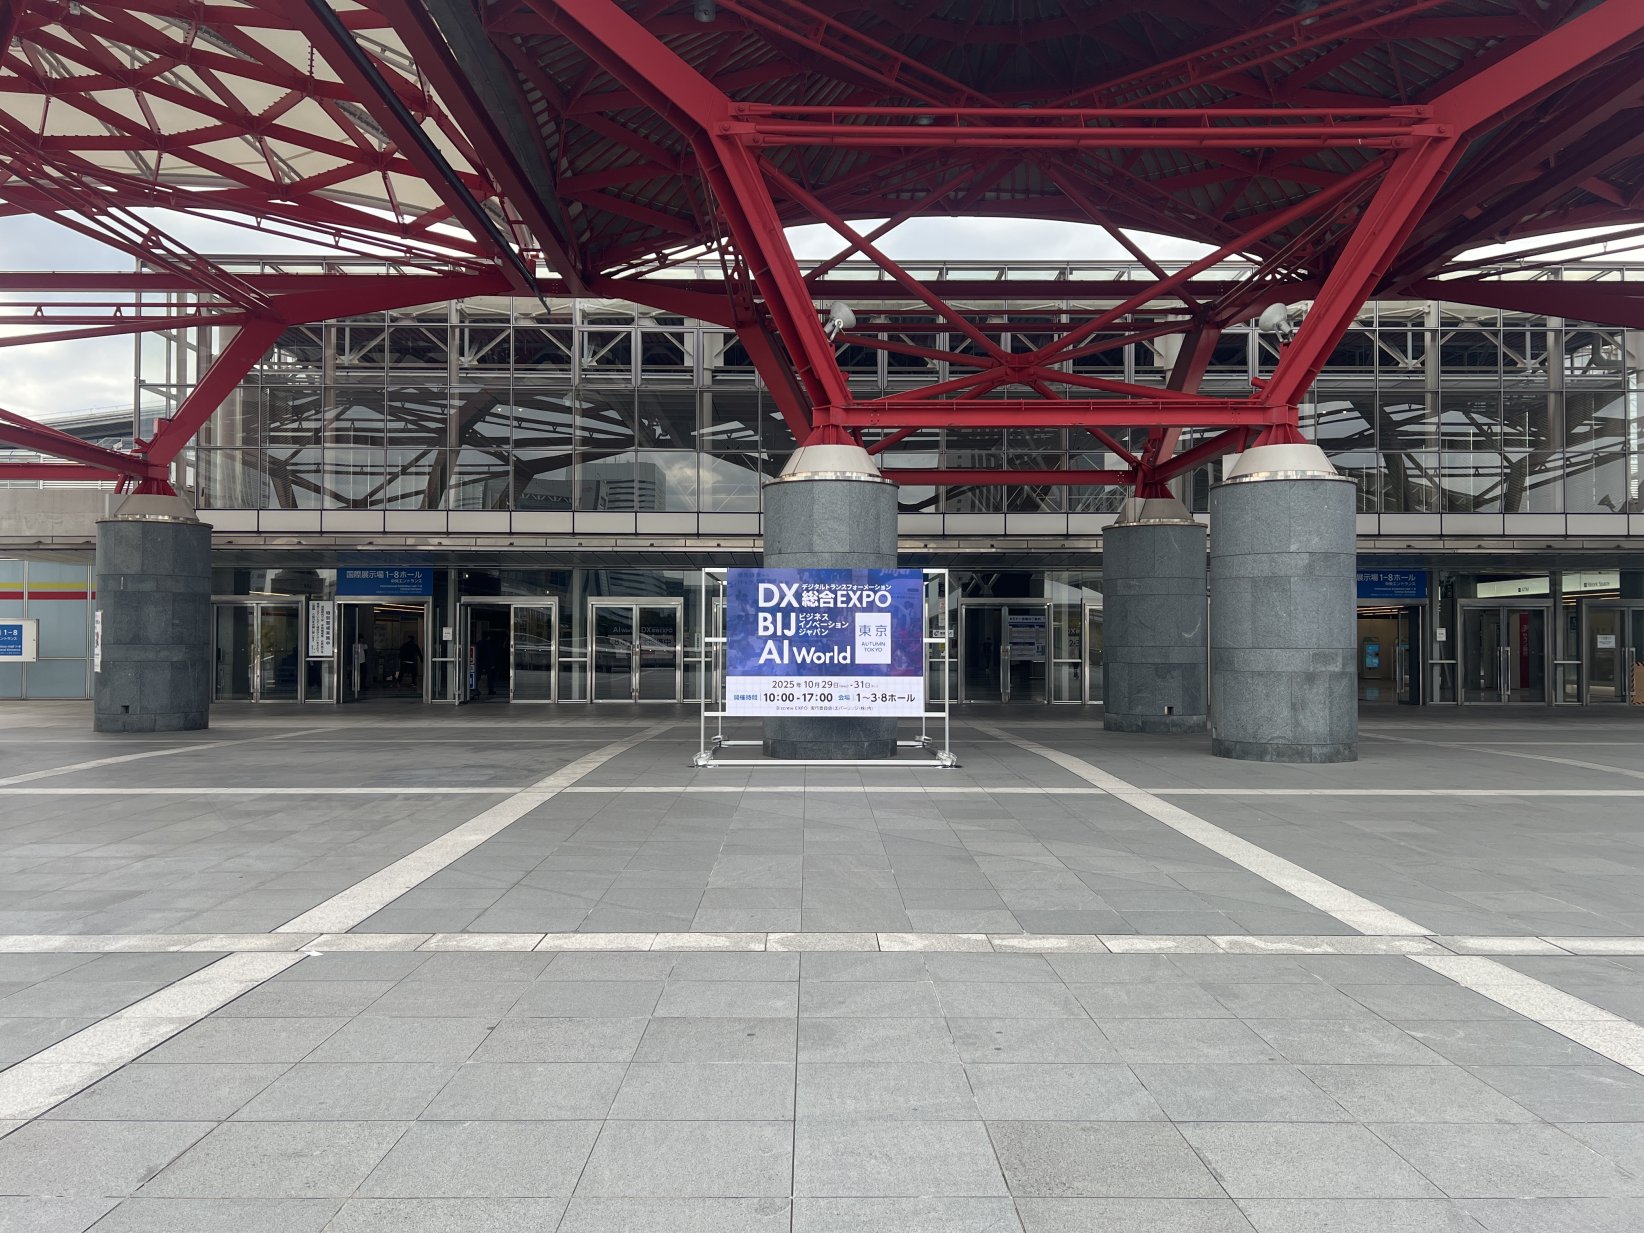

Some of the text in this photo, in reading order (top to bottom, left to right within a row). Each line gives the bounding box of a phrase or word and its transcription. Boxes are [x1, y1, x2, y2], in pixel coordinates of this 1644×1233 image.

[801, 583, 892, 591] デジタルトランスフォーメーション
[758, 583, 800, 608] DX
[801, 591, 892, 608] 総合EXPO
[758, 612, 796, 637] BIJ
[799, 613, 829, 621] ビジネス
[798, 628, 829, 637] ジャパン
[858, 624, 888, 637] 東京
[758, 639, 850, 665] AI World
